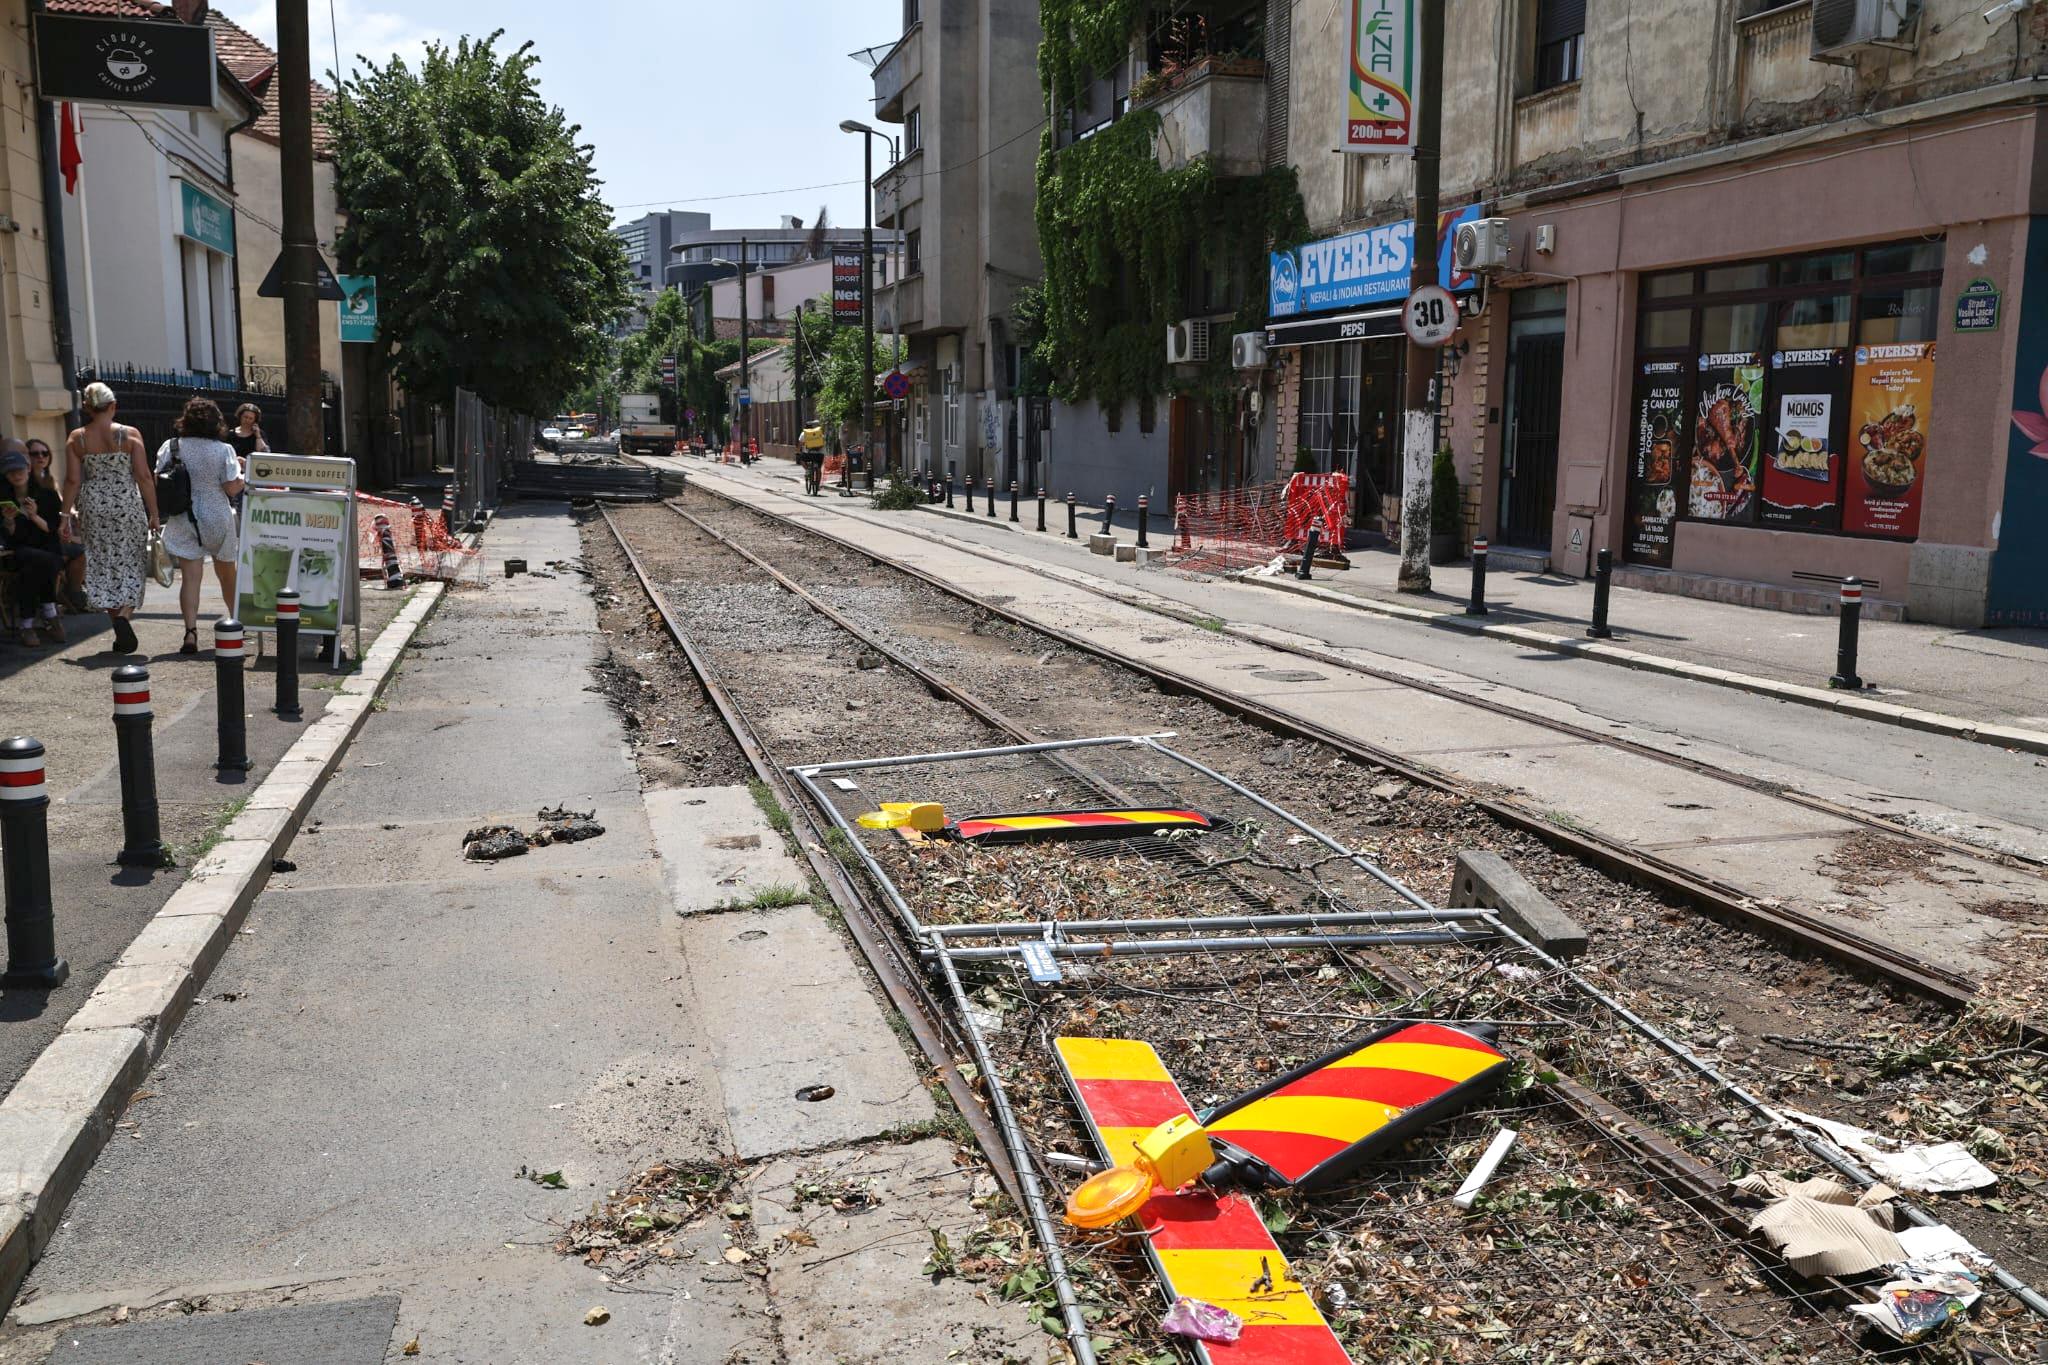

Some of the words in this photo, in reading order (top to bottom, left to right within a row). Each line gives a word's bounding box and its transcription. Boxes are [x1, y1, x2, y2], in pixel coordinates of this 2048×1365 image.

[1351, 125, 1382, 139] 200m
[835, 255, 861, 266] Net
[835, 290, 861, 301] Net
[1310, 291, 1332, 304] NEPALI
[1332, 290, 1338, 300] &
[1338, 286, 1363, 300] INDIAN
[1363, 277, 1411, 297] RESTAURANT
[1967, 298, 1987, 308] Strada
[1414, 298, 1444, 328] 30
[1958, 307, 1975, 318] Vasile
[1975, 307, 1994, 317] Lascar
[1961, 318, 1971, 326] om
[1971, 317, 1990, 328] politic
[1340, 323, 1366, 337] PEPSI
[1784, 350, 1833, 362] EVEREST
[1869, 344, 1925, 358] EVEREST
[1709, 353, 1752, 365] EVEREST
[1651, 362, 1678, 371] EVEREST
[1651, 388, 1663, 398] ALL
[1664, 388, 1680, 398] YOU
[1650, 399, 1665, 409] CAN
[1666, 399, 1679, 409] EAT
[1699, 383, 1731, 419] Chicken
[1787, 401, 1824, 417] MOMOS
[1646, 423, 1654, 453] FOOD
[316, 470, 346, 479] COFFEE
[251, 509, 301, 527] MATCHA
[304, 512, 341, 529] MENU
